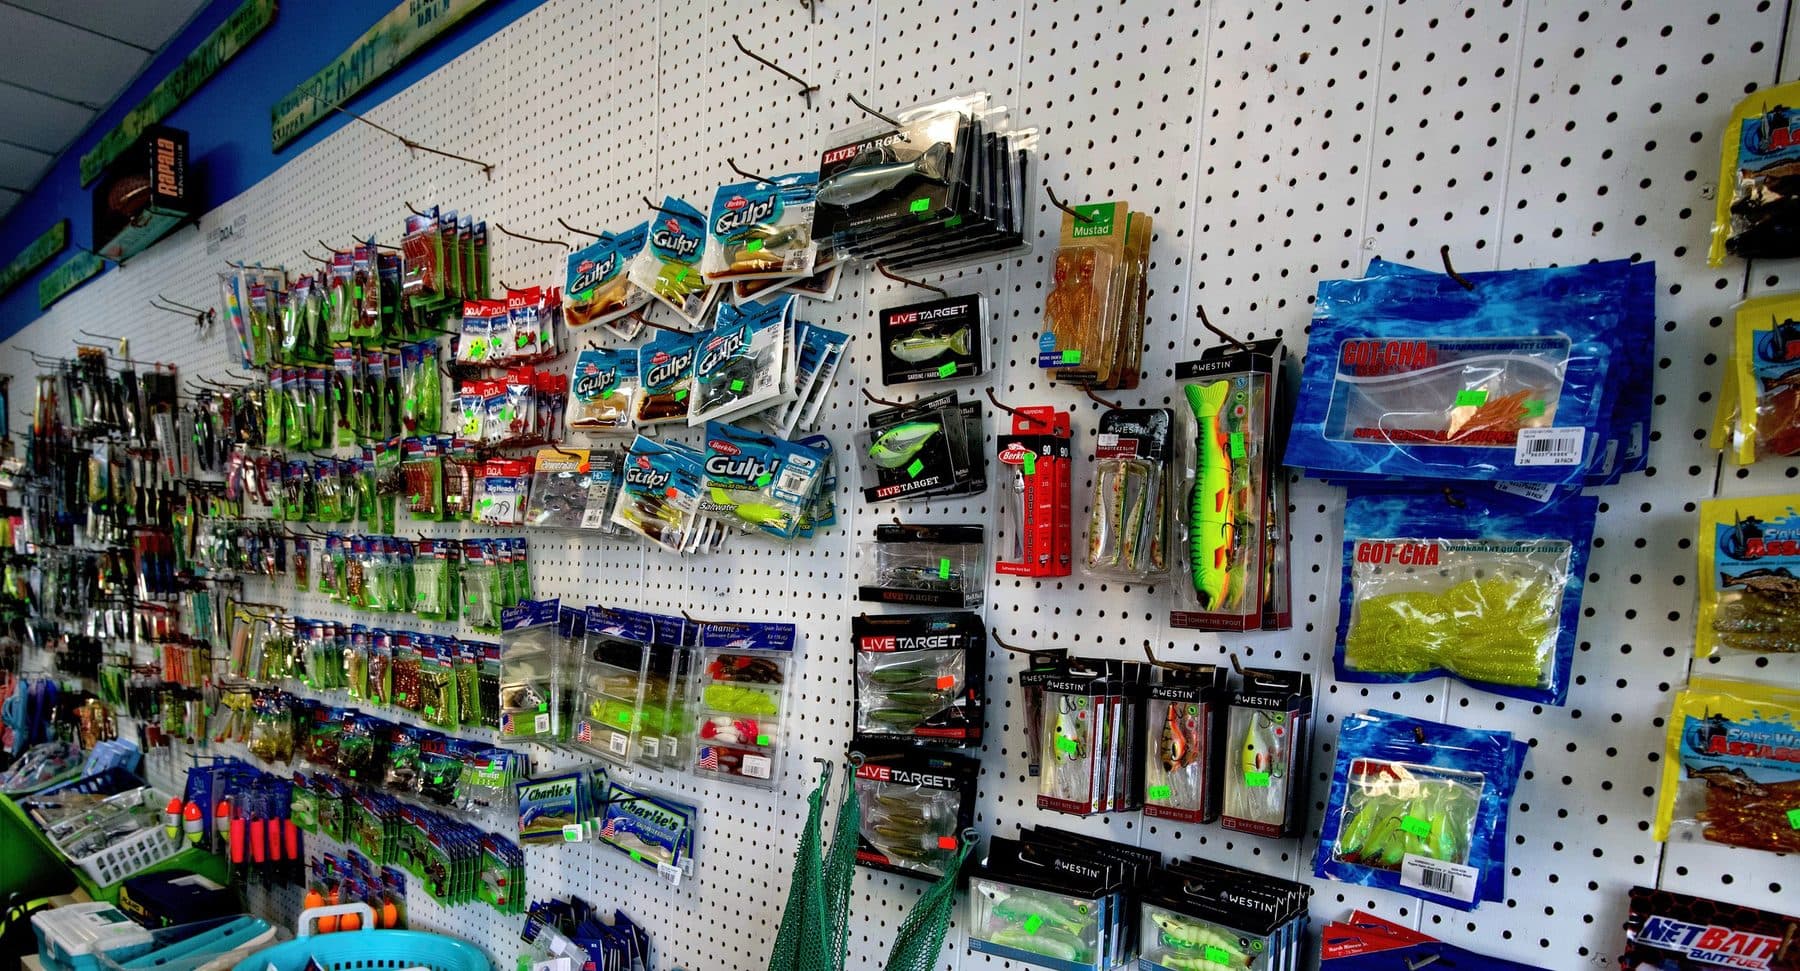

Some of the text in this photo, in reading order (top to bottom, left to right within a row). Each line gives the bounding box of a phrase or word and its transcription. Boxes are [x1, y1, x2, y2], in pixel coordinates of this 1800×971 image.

[158, 138, 178, 197] Rapala
[716, 194, 775, 234] Gulp!
[653, 229, 700, 254] Gulp!
[1074, 224, 1109, 237] Mustad
[571, 252, 615, 293] Gulp!
[699, 326, 745, 376] Gulp!
[1344, 341, 1428, 367] GOT-CHA
[647, 348, 693, 387] Gulp!
[1199, 360, 1231, 372] WESTIN
[578, 367, 616, 393] Gulp!
[712, 441, 740, 455] Berkley
[626, 468, 670, 489] Gulp!
[705, 456, 779, 483] Gulp!
[700, 500, 738, 512] Saltwater
[1357, 542, 1439, 566] GOT-CHA
[862, 635, 961, 650] LIVETARGET
[1053, 681, 1084, 691] WESTIN
[1158, 689, 1194, 699] WESTIN
[1242, 695, 1281, 707] WESTIN
[856, 765, 955, 788] LIVETARGET
[529, 784, 572, 801] Charlie's
[620, 799, 679, 831] Charlie's
[1062, 861, 1098, 878] WESTIN
[1229, 894, 1273, 912] WESTIN
[1640, 917, 1782, 959] NETBAIT
[1690, 949, 1767, 970] BAITFUEL
